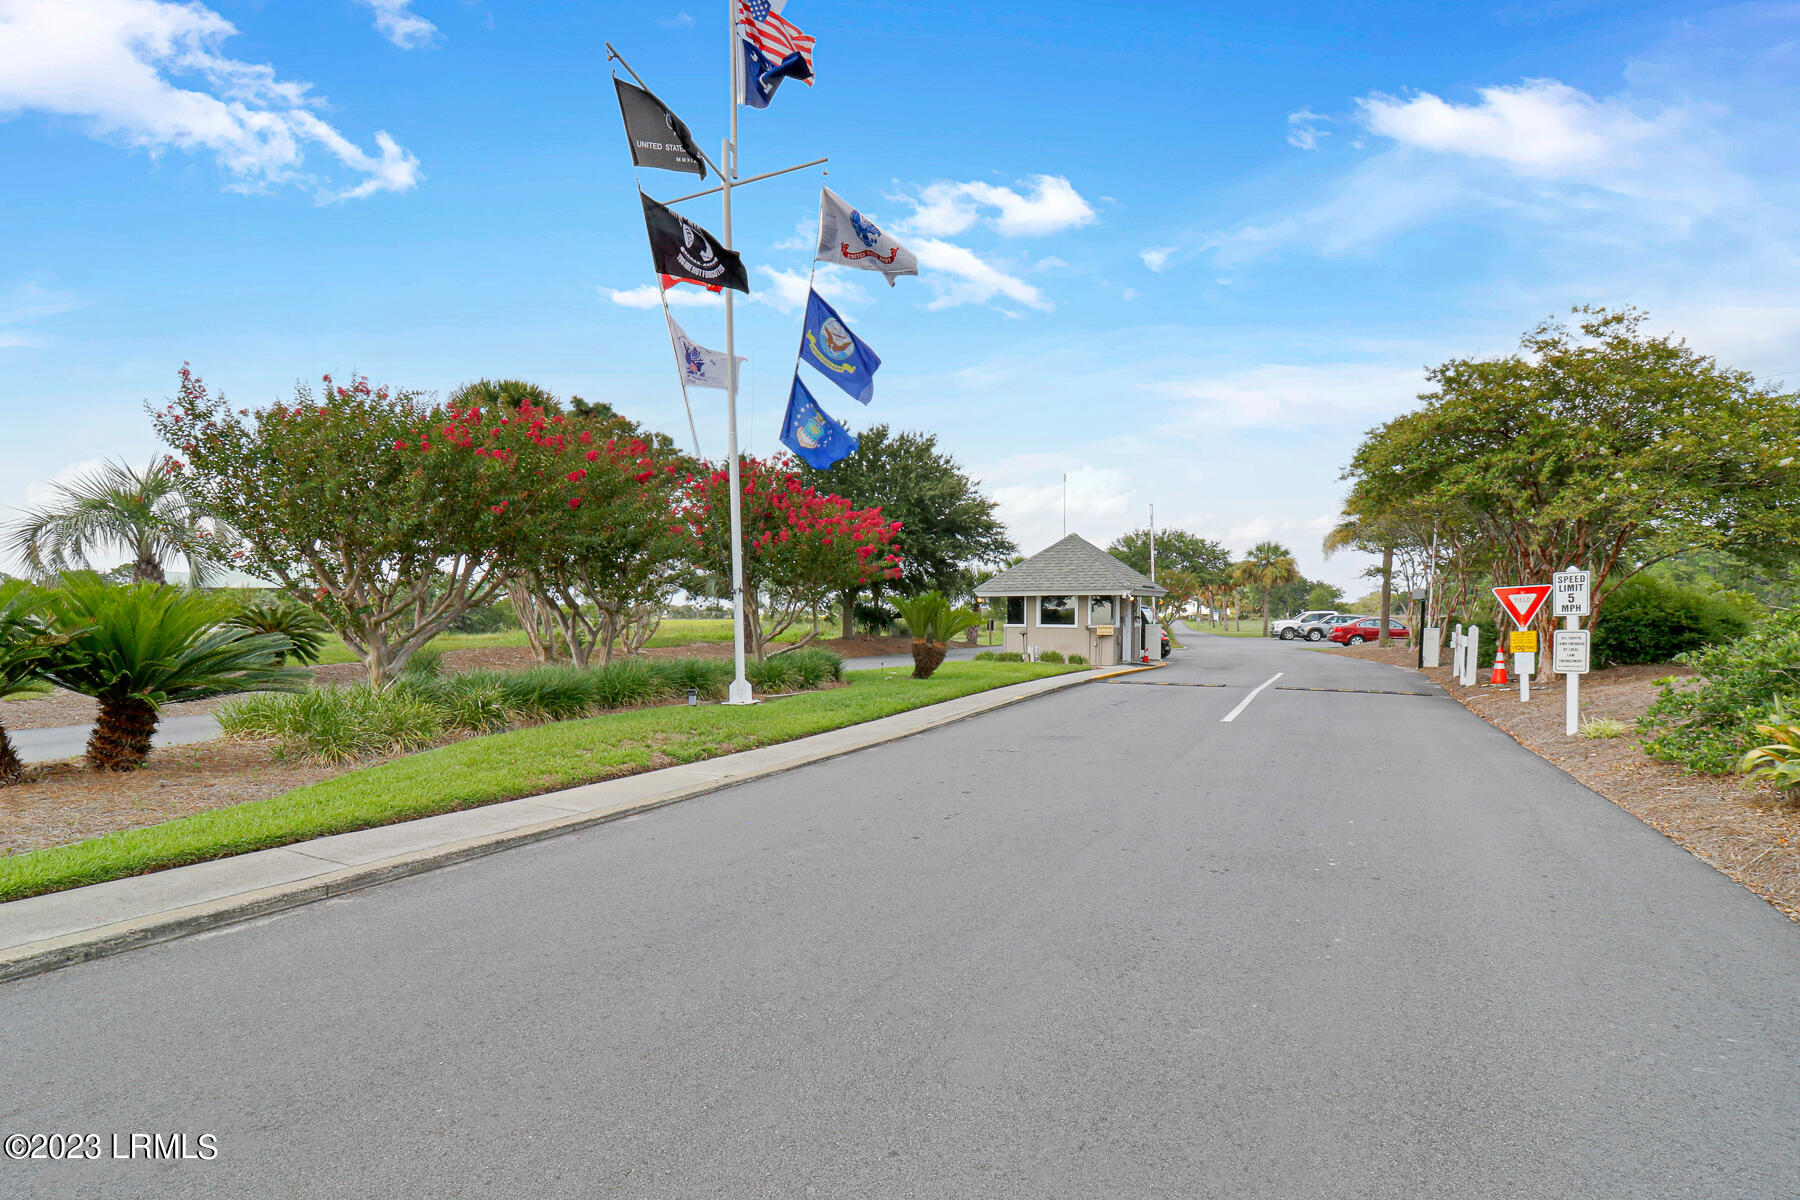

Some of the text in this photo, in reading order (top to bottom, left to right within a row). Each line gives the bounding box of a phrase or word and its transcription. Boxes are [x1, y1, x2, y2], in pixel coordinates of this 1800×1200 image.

[636, 140, 686, 152] UNITED STATE
[1557, 575, 1586, 584] SPEED
[1559, 584, 1584, 592] LIMIT
[1568, 593, 1575, 603] 5
[1561, 604, 1581, 612] MPH
